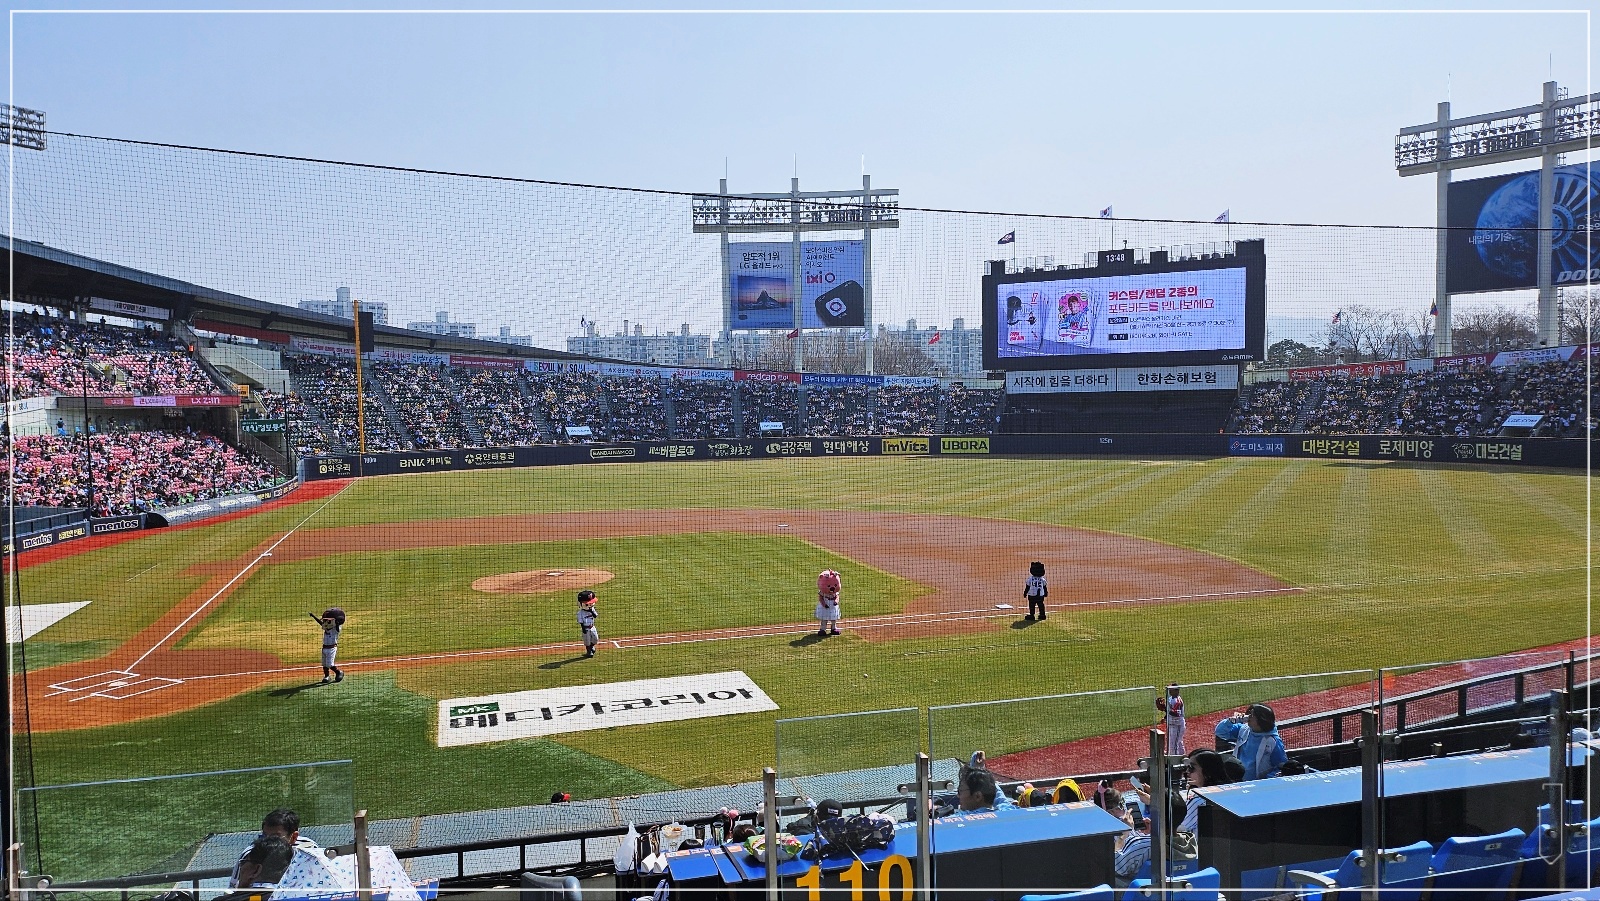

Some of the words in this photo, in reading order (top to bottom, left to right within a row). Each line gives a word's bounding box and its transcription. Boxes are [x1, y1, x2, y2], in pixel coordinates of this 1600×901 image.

[1468, 233, 1494, 245] 내일의
[743, 252, 766, 262] 압도적
[768, 251, 780, 261] 1위
[1105, 253, 1126, 263] 13:48
[1108, 288, 1166, 301] 커스텀/랜덤
[1168, 285, 1198, 298] 2종의
[1108, 301, 1159, 314] 포토카드를
[1161, 298, 1215, 311] 만나보세요
[1013, 375, 1046, 388] 시작에
[1049, 375, 1071, 388] 힘을
[1074, 373, 1109, 387] 더하다
[1137, 370, 1217, 386] 한화손해보험
[780, 441, 812, 454] 금강주택
[823, 439, 870, 454] 현대해상
[942, 440, 988, 451] UBORA
[1239, 442, 1284, 452] 도미노피자
[1302, 440, 1360, 456] 대방건설
[1378, 440, 1435, 458] 로제비앙
[1476, 443, 1522, 461] 대보건설
[400, 459, 426, 468] BNK
[427, 456, 452, 465] 캐피탈
[474, 452, 515, 462] 유안타증권
[94, 520, 139, 533] mentos
[23, 533, 53, 549] mentos
[796, 854, 914, 901] 110
